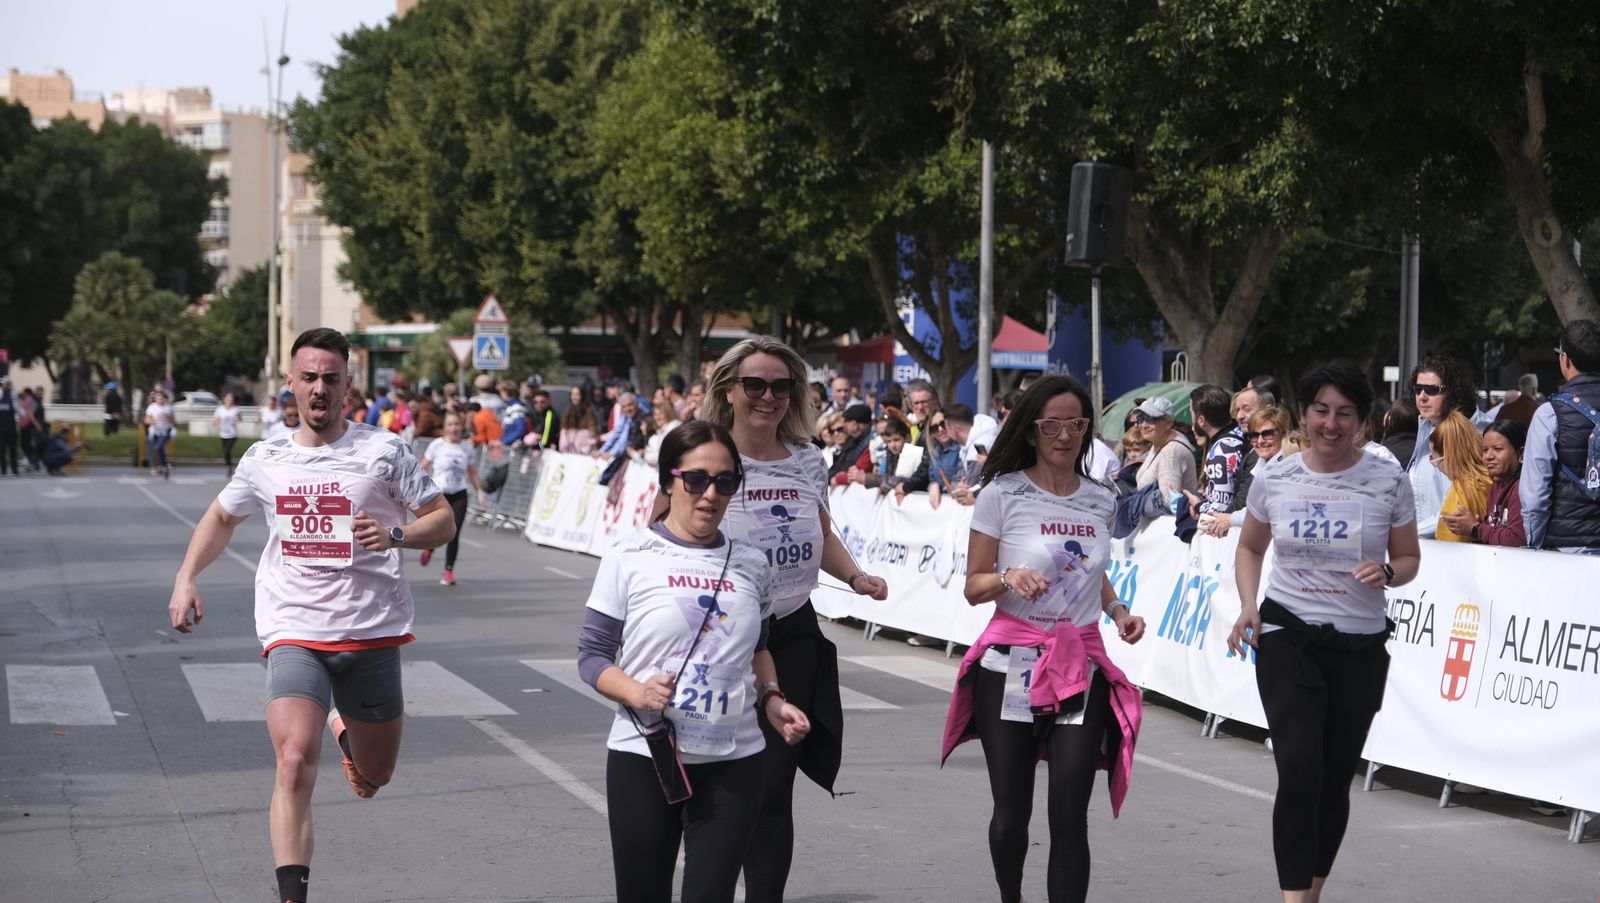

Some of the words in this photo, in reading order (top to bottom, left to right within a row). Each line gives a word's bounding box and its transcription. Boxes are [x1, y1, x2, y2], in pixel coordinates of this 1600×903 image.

[288, 482, 341, 495] MUJER
[747, 489, 800, 501] MUJER
[291, 515, 334, 534] 906
[1040, 523, 1096, 538] MUJER
[1289, 519, 1348, 539] 1212
[764, 542, 813, 567] 1098
[668, 575, 737, 593] MUJER
[1492, 671, 1559, 710] CIUDAD
[669, 687, 728, 715] 211
[685, 711, 708, 721] PAQUI
